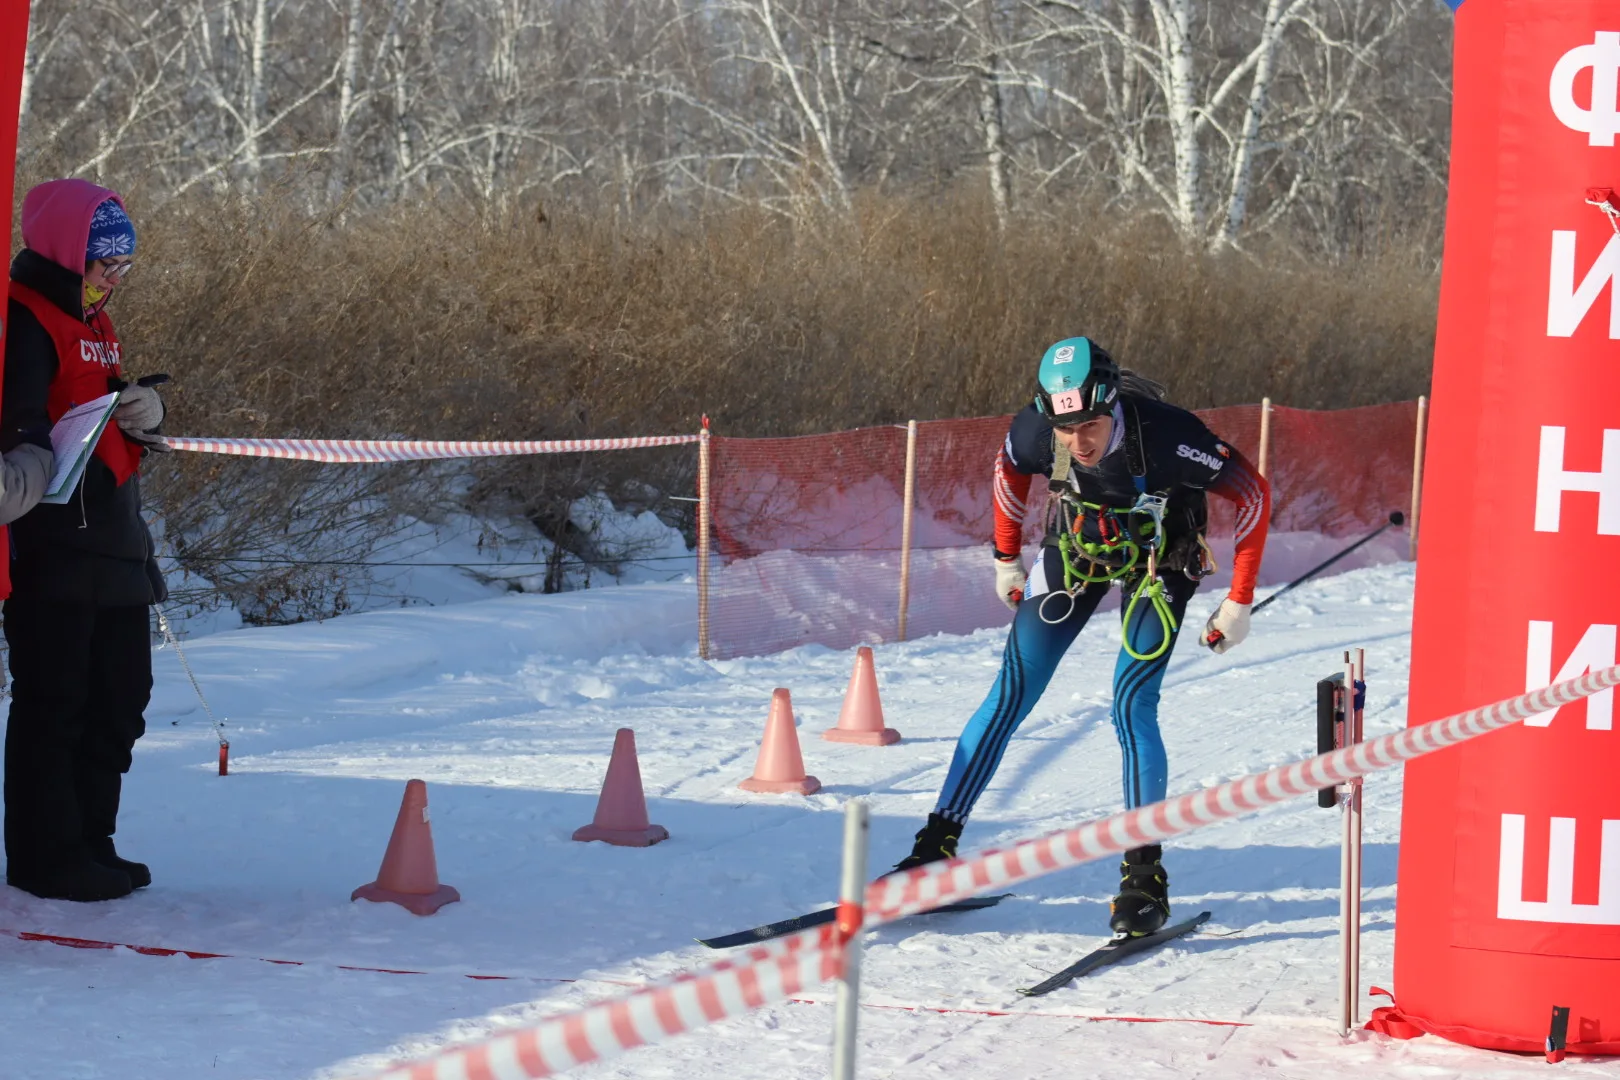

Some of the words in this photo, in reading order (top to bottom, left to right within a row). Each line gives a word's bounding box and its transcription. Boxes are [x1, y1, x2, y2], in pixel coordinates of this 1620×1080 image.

[1060, 397, 1073, 409] 12
[1175, 444, 1224, 471] SCANIA
[1496, 30, 1620, 926] ФИНИШ
